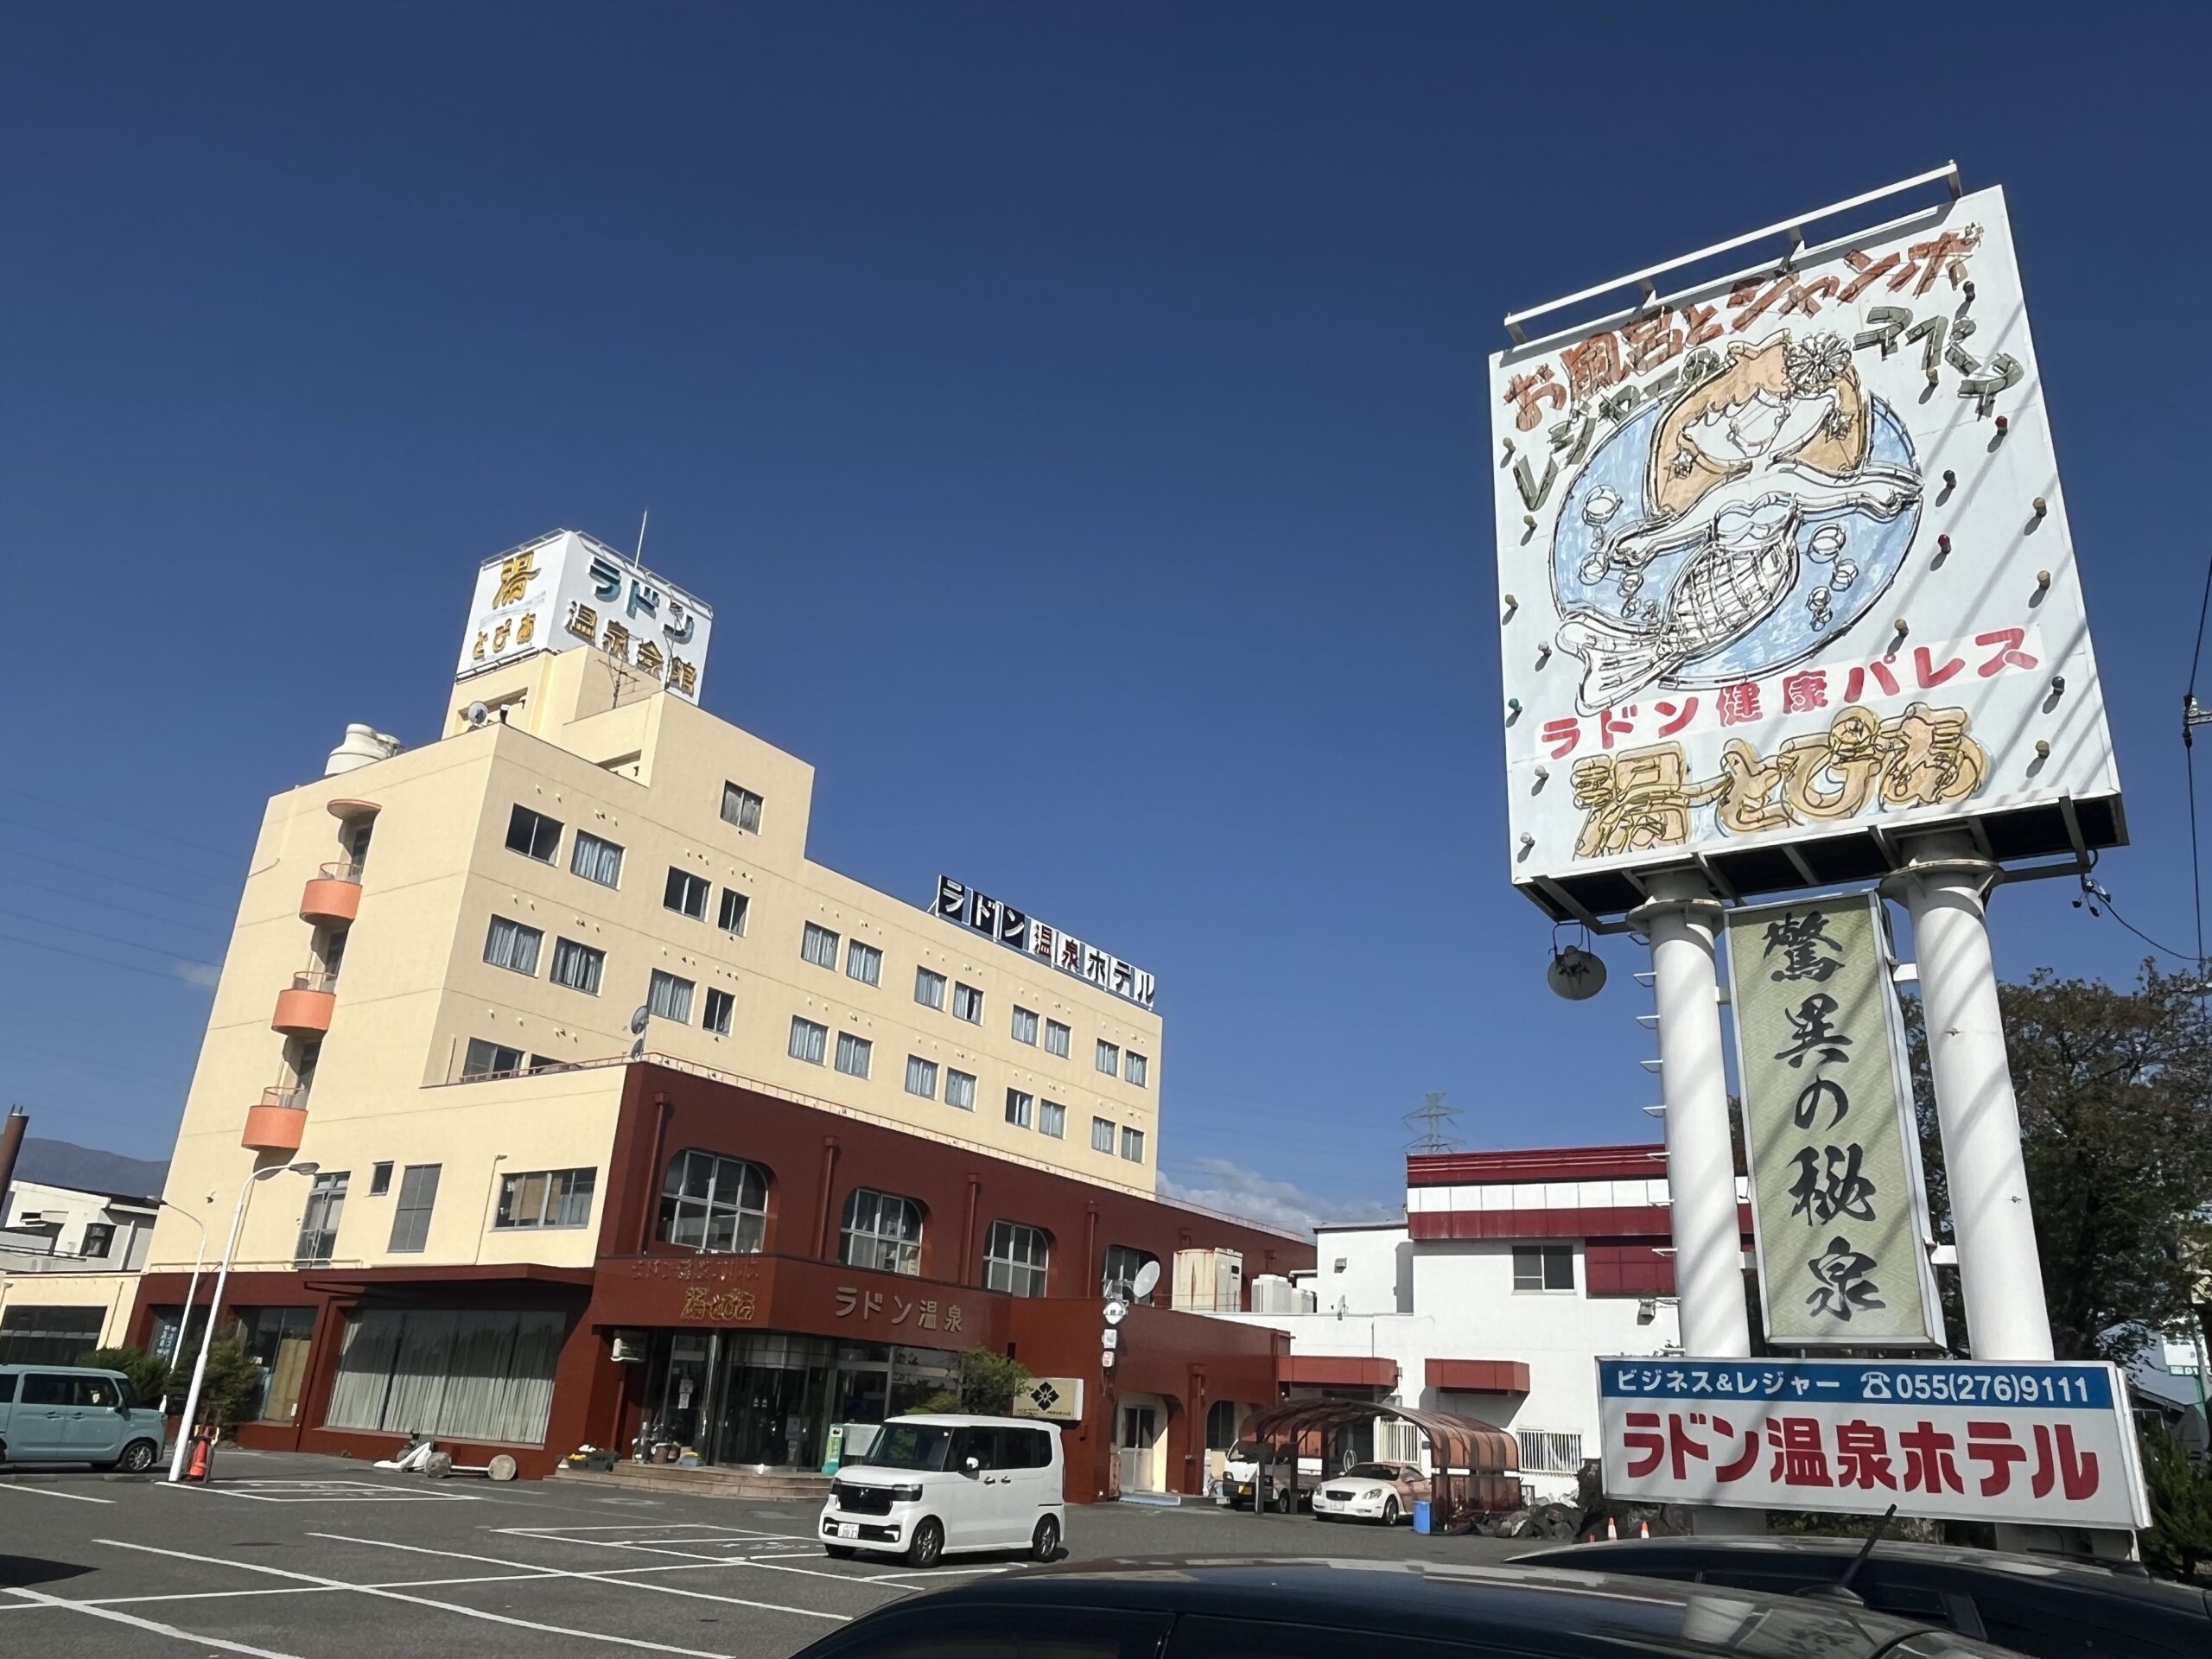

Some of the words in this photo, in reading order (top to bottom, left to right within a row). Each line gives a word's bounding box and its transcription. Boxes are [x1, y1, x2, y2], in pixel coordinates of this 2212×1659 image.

[1503, 221, 1985, 432] お風呂とジャンボ
[563, 600, 697, 697] 温泉会館
[588, 556, 695, 645] ラドン
[1541, 627, 2038, 760] ラドン健康パレス
[942, 879, 1155, 1005] ラドン温泉ホテル
[1763, 910, 1887, 1323] 驚異の秘泉
[836, 1287, 963, 1333] ラドン温泉
[1617, 1369, 1840, 1397] ビジネス&レジャー
[1896, 1371, 2089, 1404] 055(276)9111
[1622, 1411, 2100, 1502] ラドン温泉ホテル
